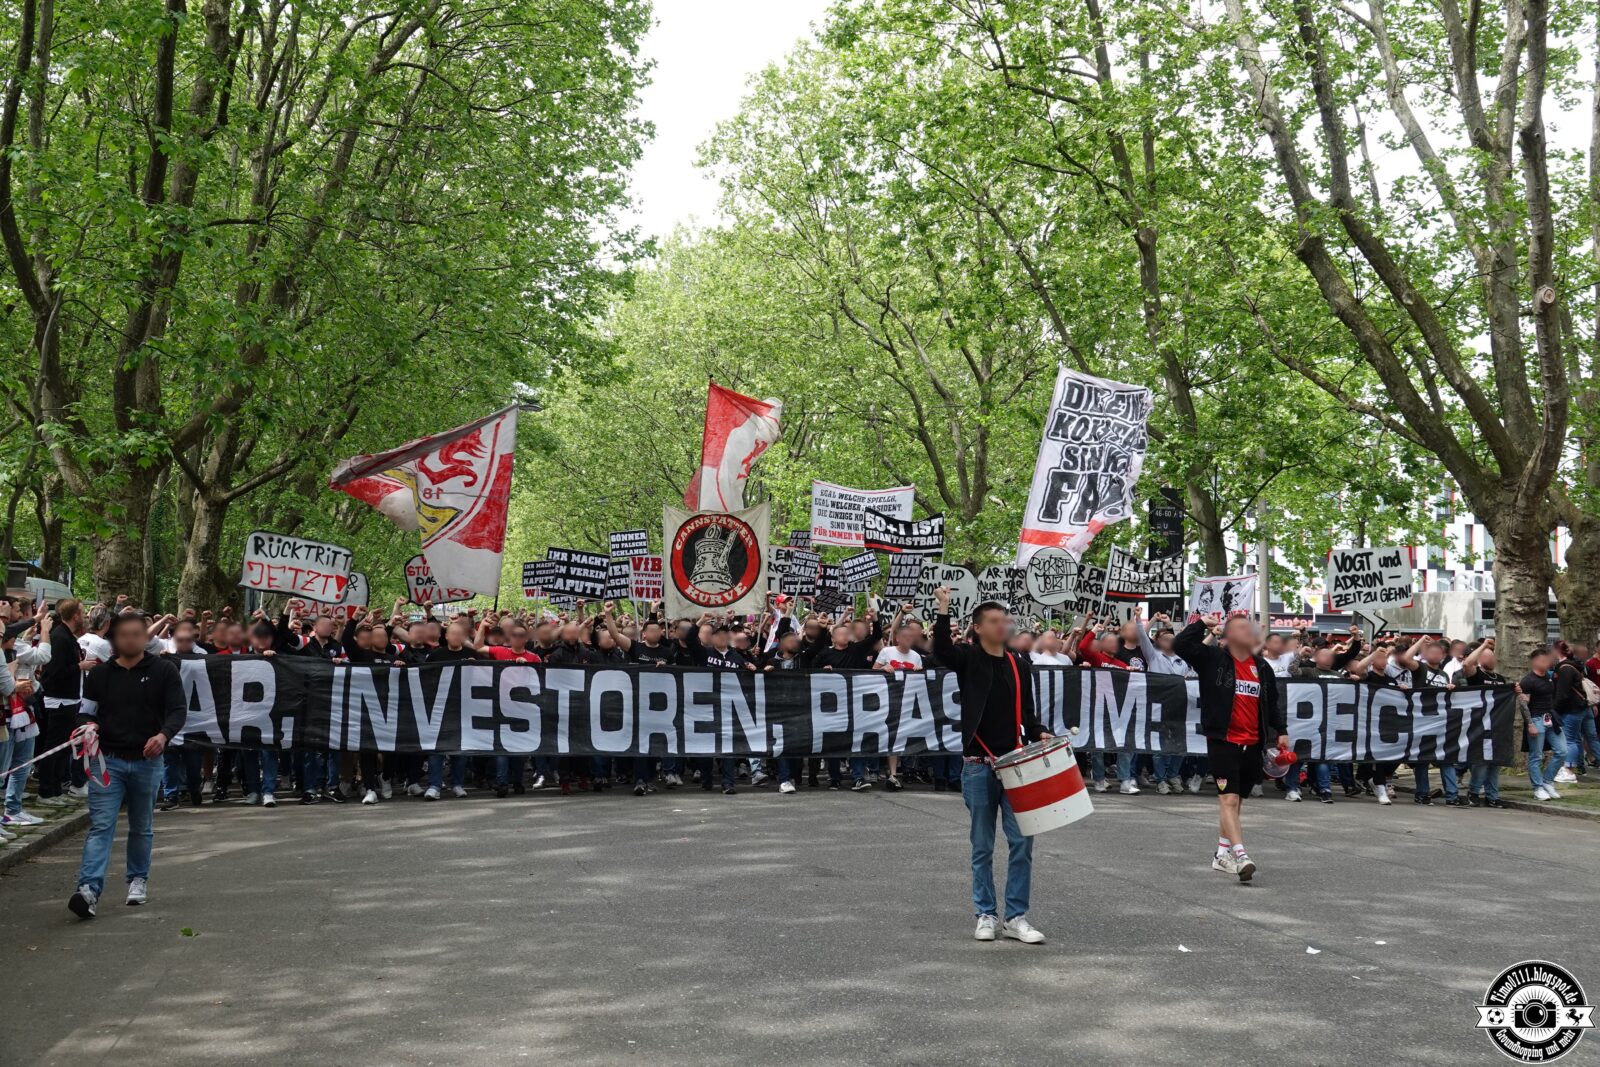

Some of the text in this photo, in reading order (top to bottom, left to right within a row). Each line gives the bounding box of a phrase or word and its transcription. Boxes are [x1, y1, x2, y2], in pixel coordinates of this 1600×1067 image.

[838, 492, 866, 503] WELCHE
[830, 501, 861, 512] WELCHER
[675, 514, 754, 551] CANNSTATTER
[813, 526, 827, 536] FÜR
[828, 530, 853, 541] IMMER
[911, 516, 943, 536] IST
[865, 529, 943, 546] UNANTASTBAR!
[548, 550, 610, 567] IHR MACHT
[612, 548, 648, 557] SCHLANGE
[893, 554, 923, 564] VOGT
[1333, 550, 1402, 573] VOGT und
[569, 567, 607, 579] VEREIN
[791, 565, 816, 578] MAUL
[847, 567, 880, 583] SCHLANGE
[889, 565, 920, 578] UND
[941, 569, 965, 582] UND
[246, 560, 349, 600] JETZT!
[416, 576, 438, 586] DAS
[545, 578, 604, 596] APUTT
[1333, 570, 1384, 592] ADRION
[684, 582, 747, 604] KURVE
[783, 584, 815, 593] JETZT
[885, 586, 916, 595] RAUS
[1332, 590, 1364, 608] ZEIT
[1380, 584, 1412, 603] GEHN!
[329, 665, 784, 757] INVESTOREN,
[810, 669, 1162, 755] PRÄSIUM:
[1286, 682, 1496, 763] REICHT!
